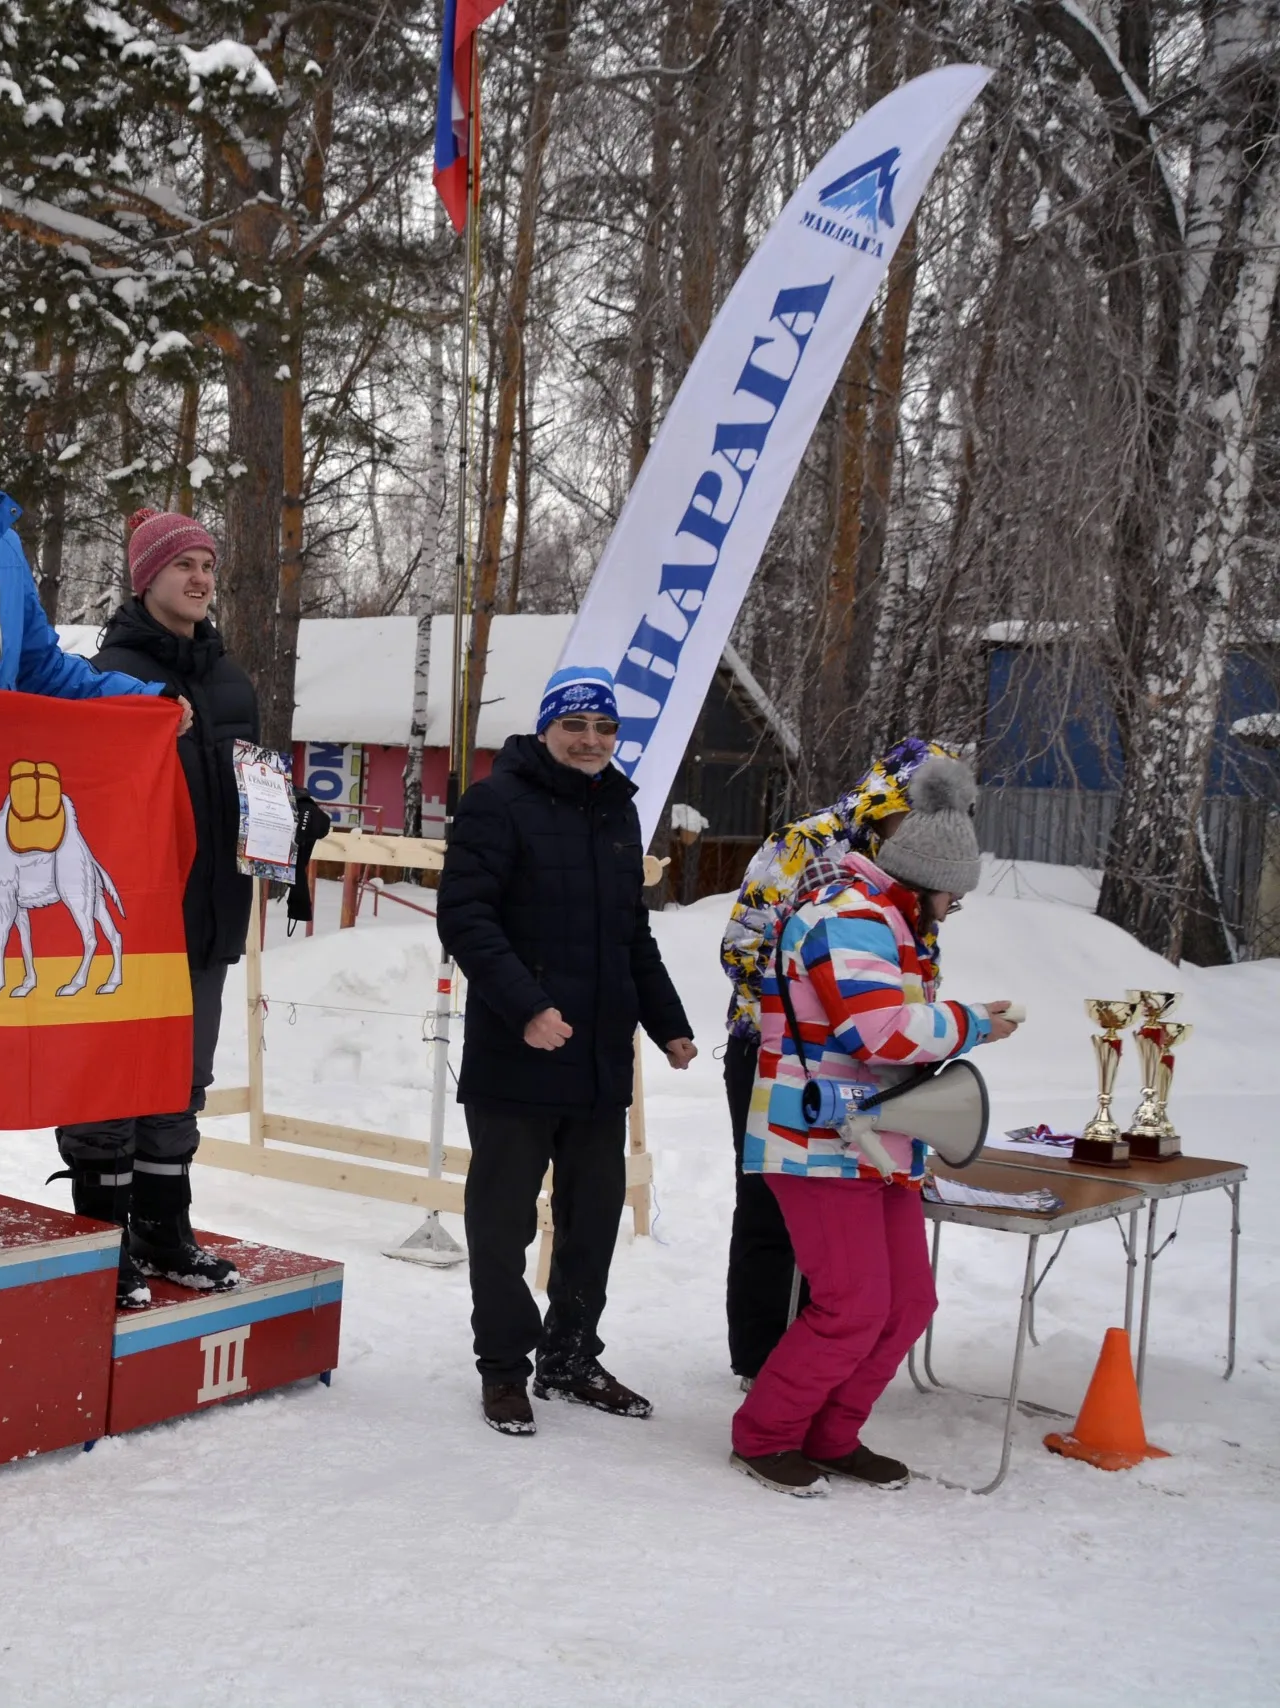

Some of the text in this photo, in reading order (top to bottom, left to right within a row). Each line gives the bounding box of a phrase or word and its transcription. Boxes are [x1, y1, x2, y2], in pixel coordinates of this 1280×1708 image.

[799, 211, 884, 258] МАНАРАГА
[613, 275, 834, 780] АНАРАГА
[559, 703, 599, 714] 2014
[197, 1323, 251, 1404] III
